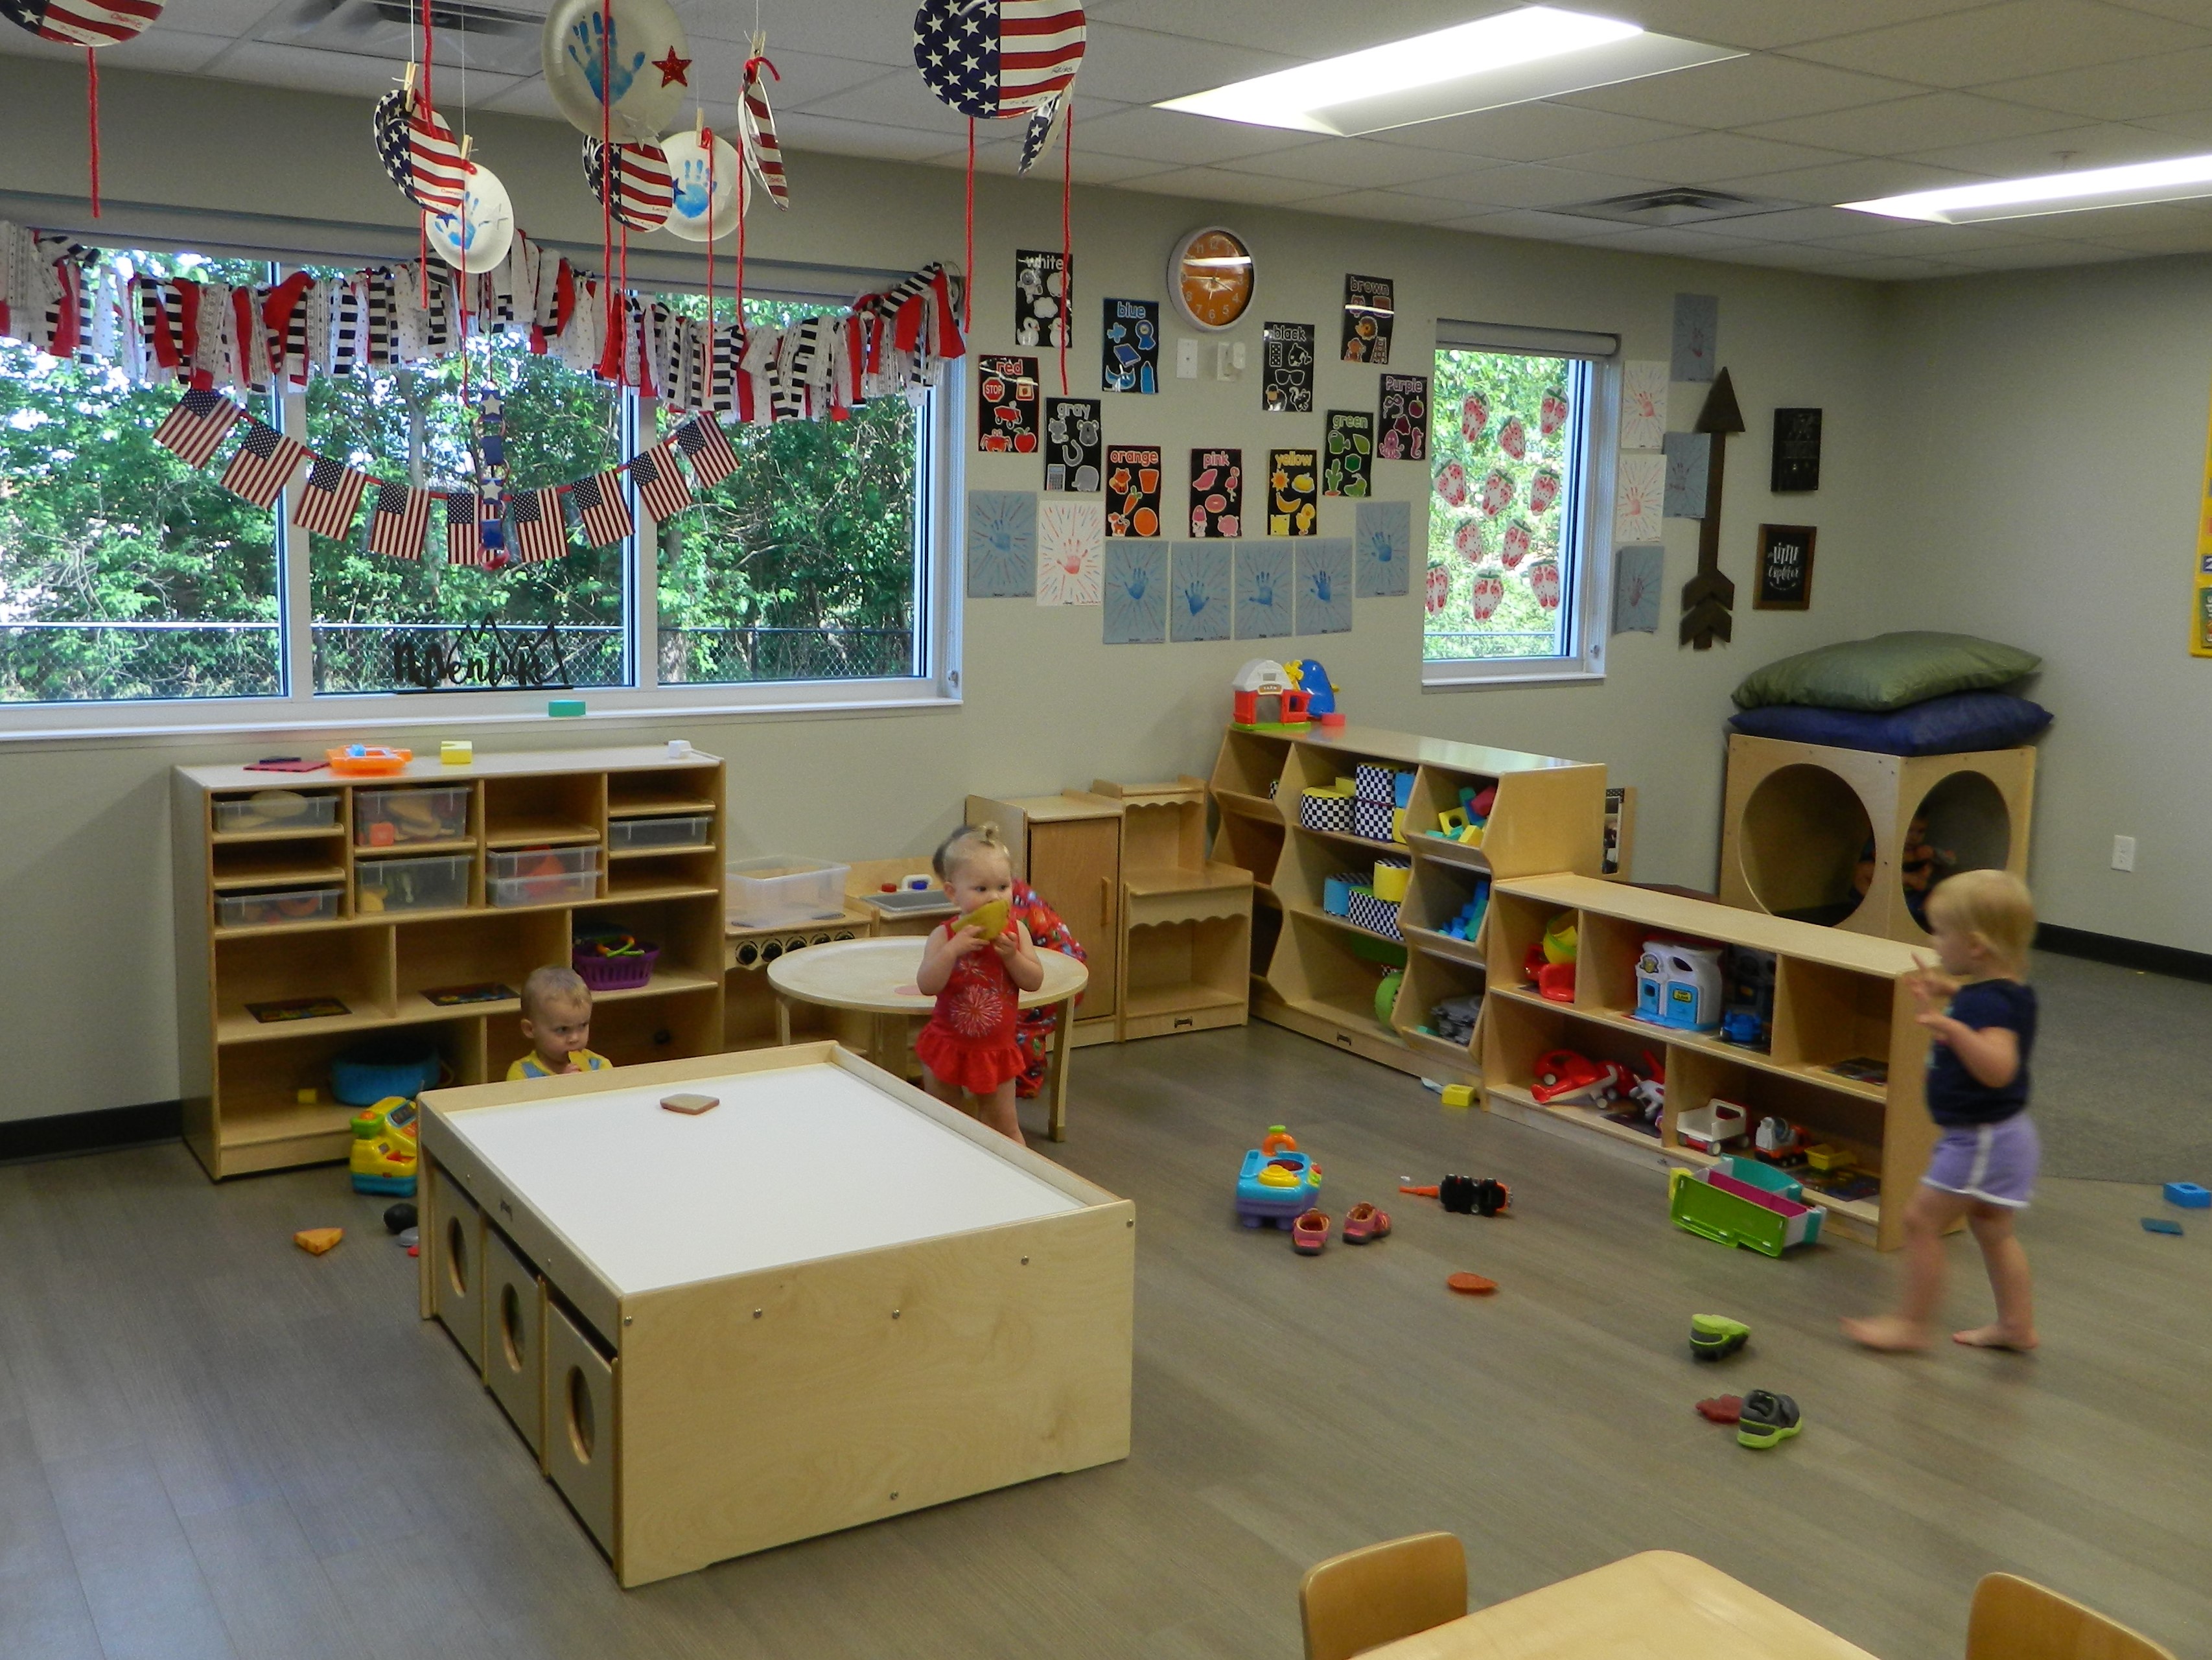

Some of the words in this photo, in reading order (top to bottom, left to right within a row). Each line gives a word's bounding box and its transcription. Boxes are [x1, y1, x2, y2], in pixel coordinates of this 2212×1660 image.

[1025, 253, 1064, 270] white
[1350, 277, 1389, 296] brown
[1117, 301, 1147, 319] blue
[1209, 309, 1216, 319] 6
[1274, 325, 1307, 341] black
[996, 359, 1023, 376] red
[985, 384, 1002, 394] STOP
[1386, 376, 1423, 394] Purple
[1057, 403, 1091, 419] gray
[1333, 414, 1368, 430] green
[1110, 449, 1158, 467] orange
[1203, 451, 1229, 469] pink
[1274, 450, 1312, 469] yellow
